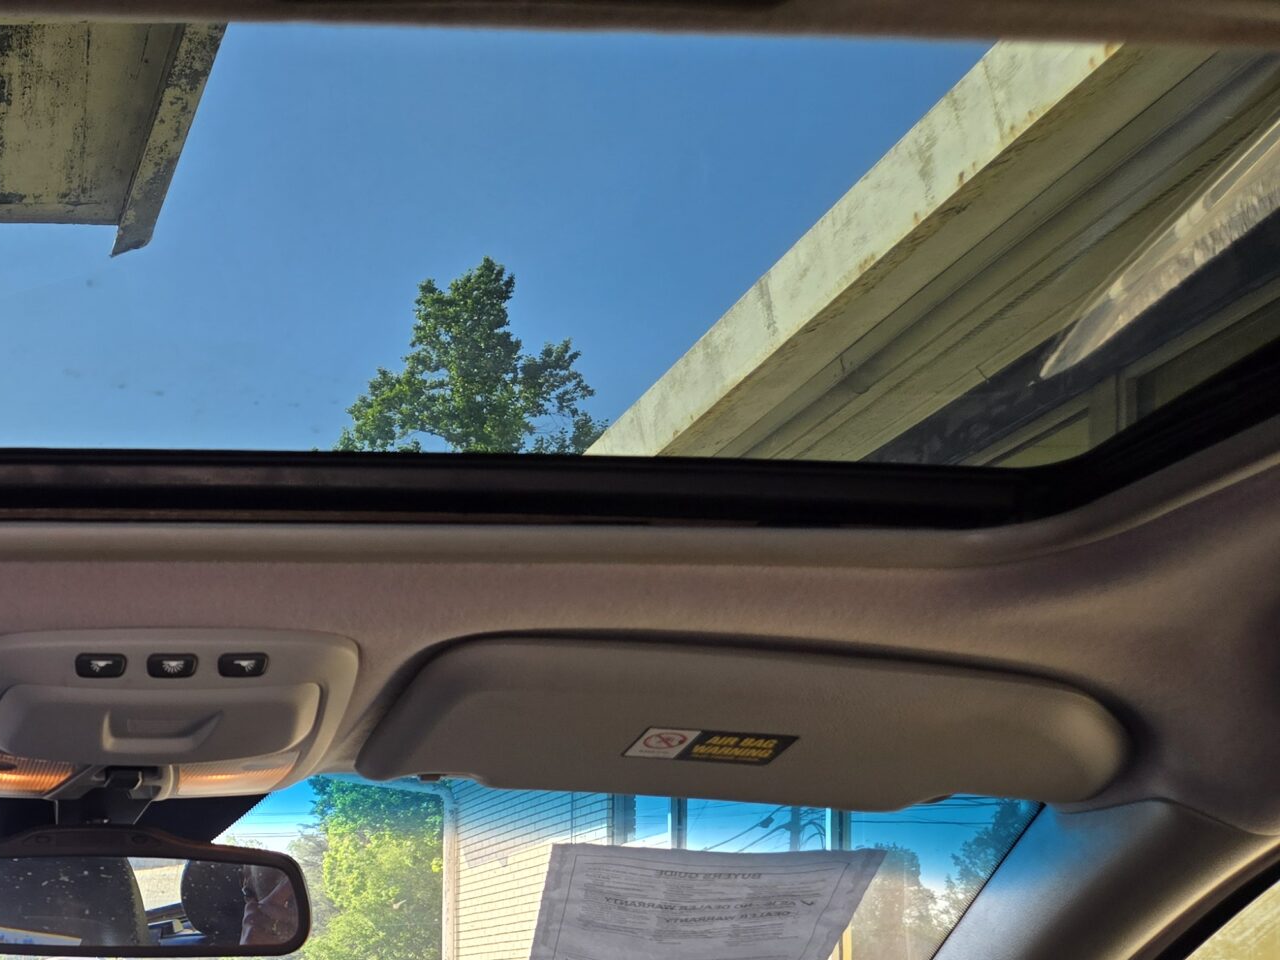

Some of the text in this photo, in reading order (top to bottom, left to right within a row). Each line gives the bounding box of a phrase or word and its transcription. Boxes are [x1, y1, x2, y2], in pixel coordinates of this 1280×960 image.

[705, 736, 778, 748] AIR BAG
[691, 744, 772, 758] WARNING
